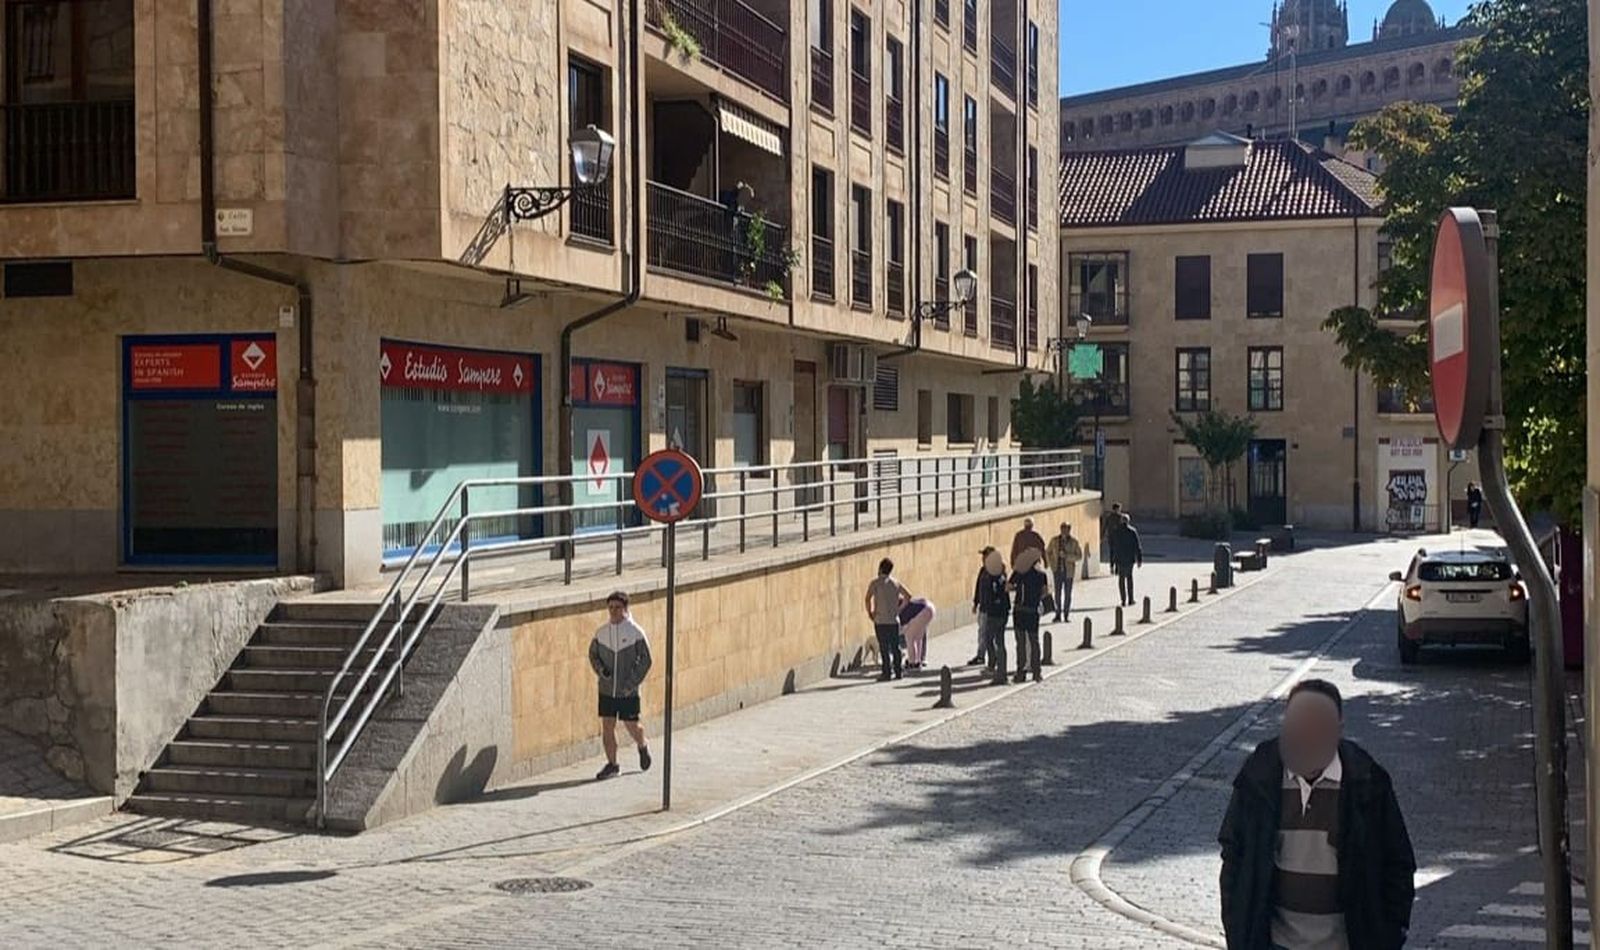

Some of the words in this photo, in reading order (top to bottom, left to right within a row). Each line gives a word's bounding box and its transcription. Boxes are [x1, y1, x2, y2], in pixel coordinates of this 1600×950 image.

[135, 358, 170, 366] EXPERTS
[135, 368, 144, 376] IN
[147, 367, 184, 377] SPANISH
[404, 352, 448, 380] Estudio
[457, 358, 502, 390] Sampere
[232, 375, 276, 390] Sampere
[606, 377, 632, 398] Sampere
